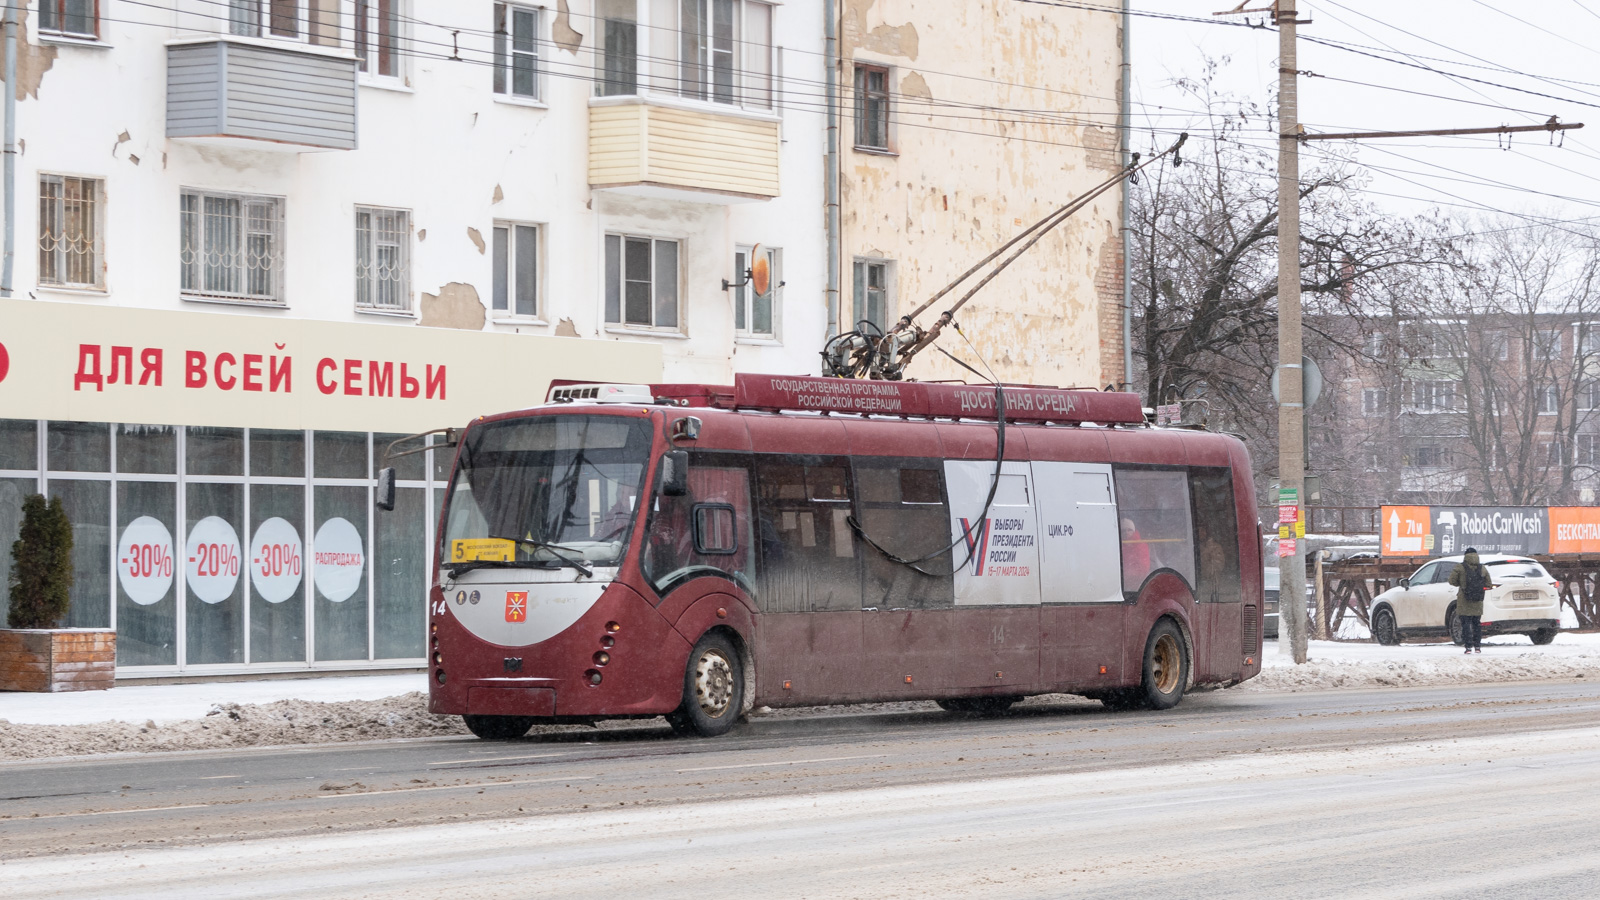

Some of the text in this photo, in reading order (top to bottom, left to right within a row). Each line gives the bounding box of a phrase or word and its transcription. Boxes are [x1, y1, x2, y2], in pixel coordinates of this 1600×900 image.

[74, 342, 446, 400] ДЛЯ ВСЕЙ СЕМЬИ
[770, 379, 901, 396] ГОСУДАРСТВЕННАЯ ПРОГРАММА
[798, 394, 902, 411] РОССИЙСКОЙ ФЕДЕРАЦИИ
[994, 518, 1025, 531] ВЫБОРЫ
[1048, 524, 1074, 538] ЦИК.РФ
[992, 534, 1034, 548] ПРЕЗИДЕНТА
[315, 552, 361, 567] РАСПРОДАЖА
[455, 542, 464, 560] 5
[989, 550, 1017, 563] РОССИИ
[121, 543, 172, 578] -30%
[189, 543, 238, 577] -20%
[254, 543, 300, 577] -30%
[1002, 566, 1018, 576] МАРТА
[1018, 566, 1030, 577] 2024
[431, 600, 446, 616] 14
[991, 625, 1005, 645] 14
